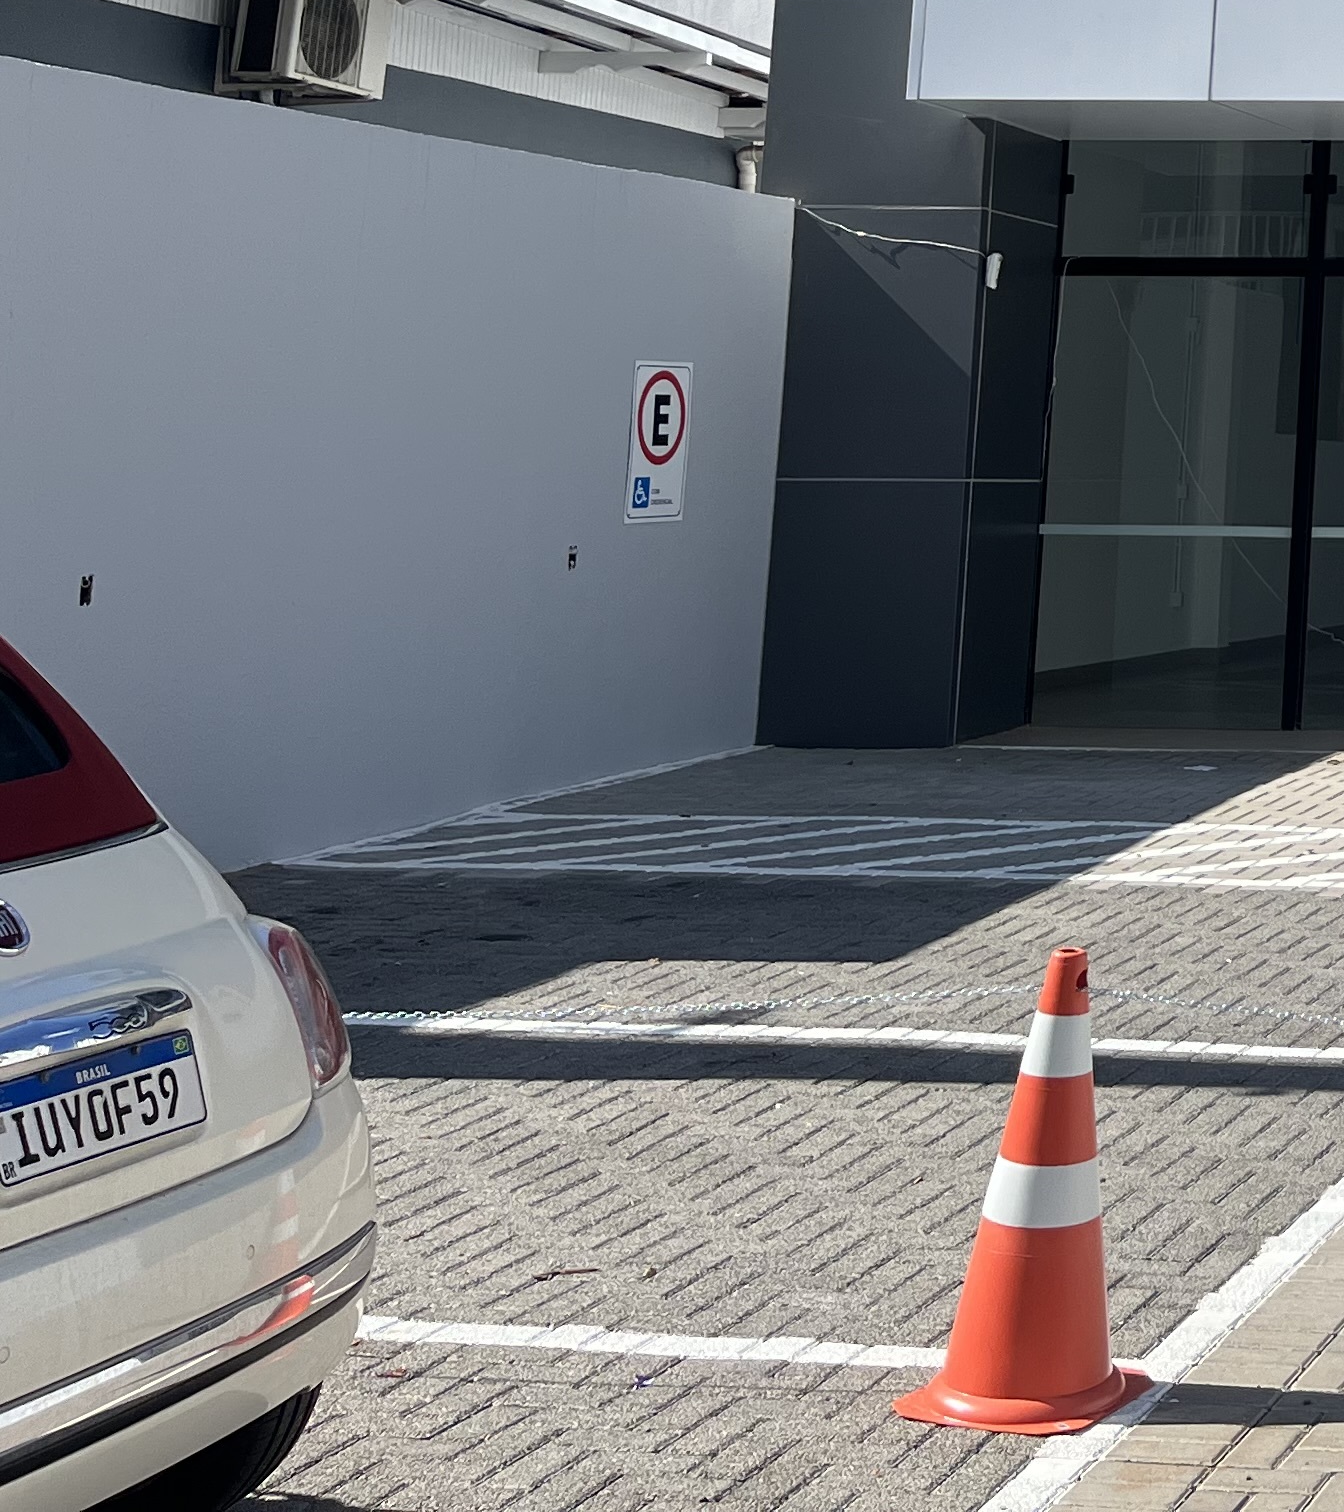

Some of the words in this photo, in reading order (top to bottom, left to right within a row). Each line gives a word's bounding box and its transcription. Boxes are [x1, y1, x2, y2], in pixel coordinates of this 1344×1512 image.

[651, 394, 671, 447] E
[75, 1063, 111, 1085] BRASIL
[2, 1161, 18, 1180] BR
